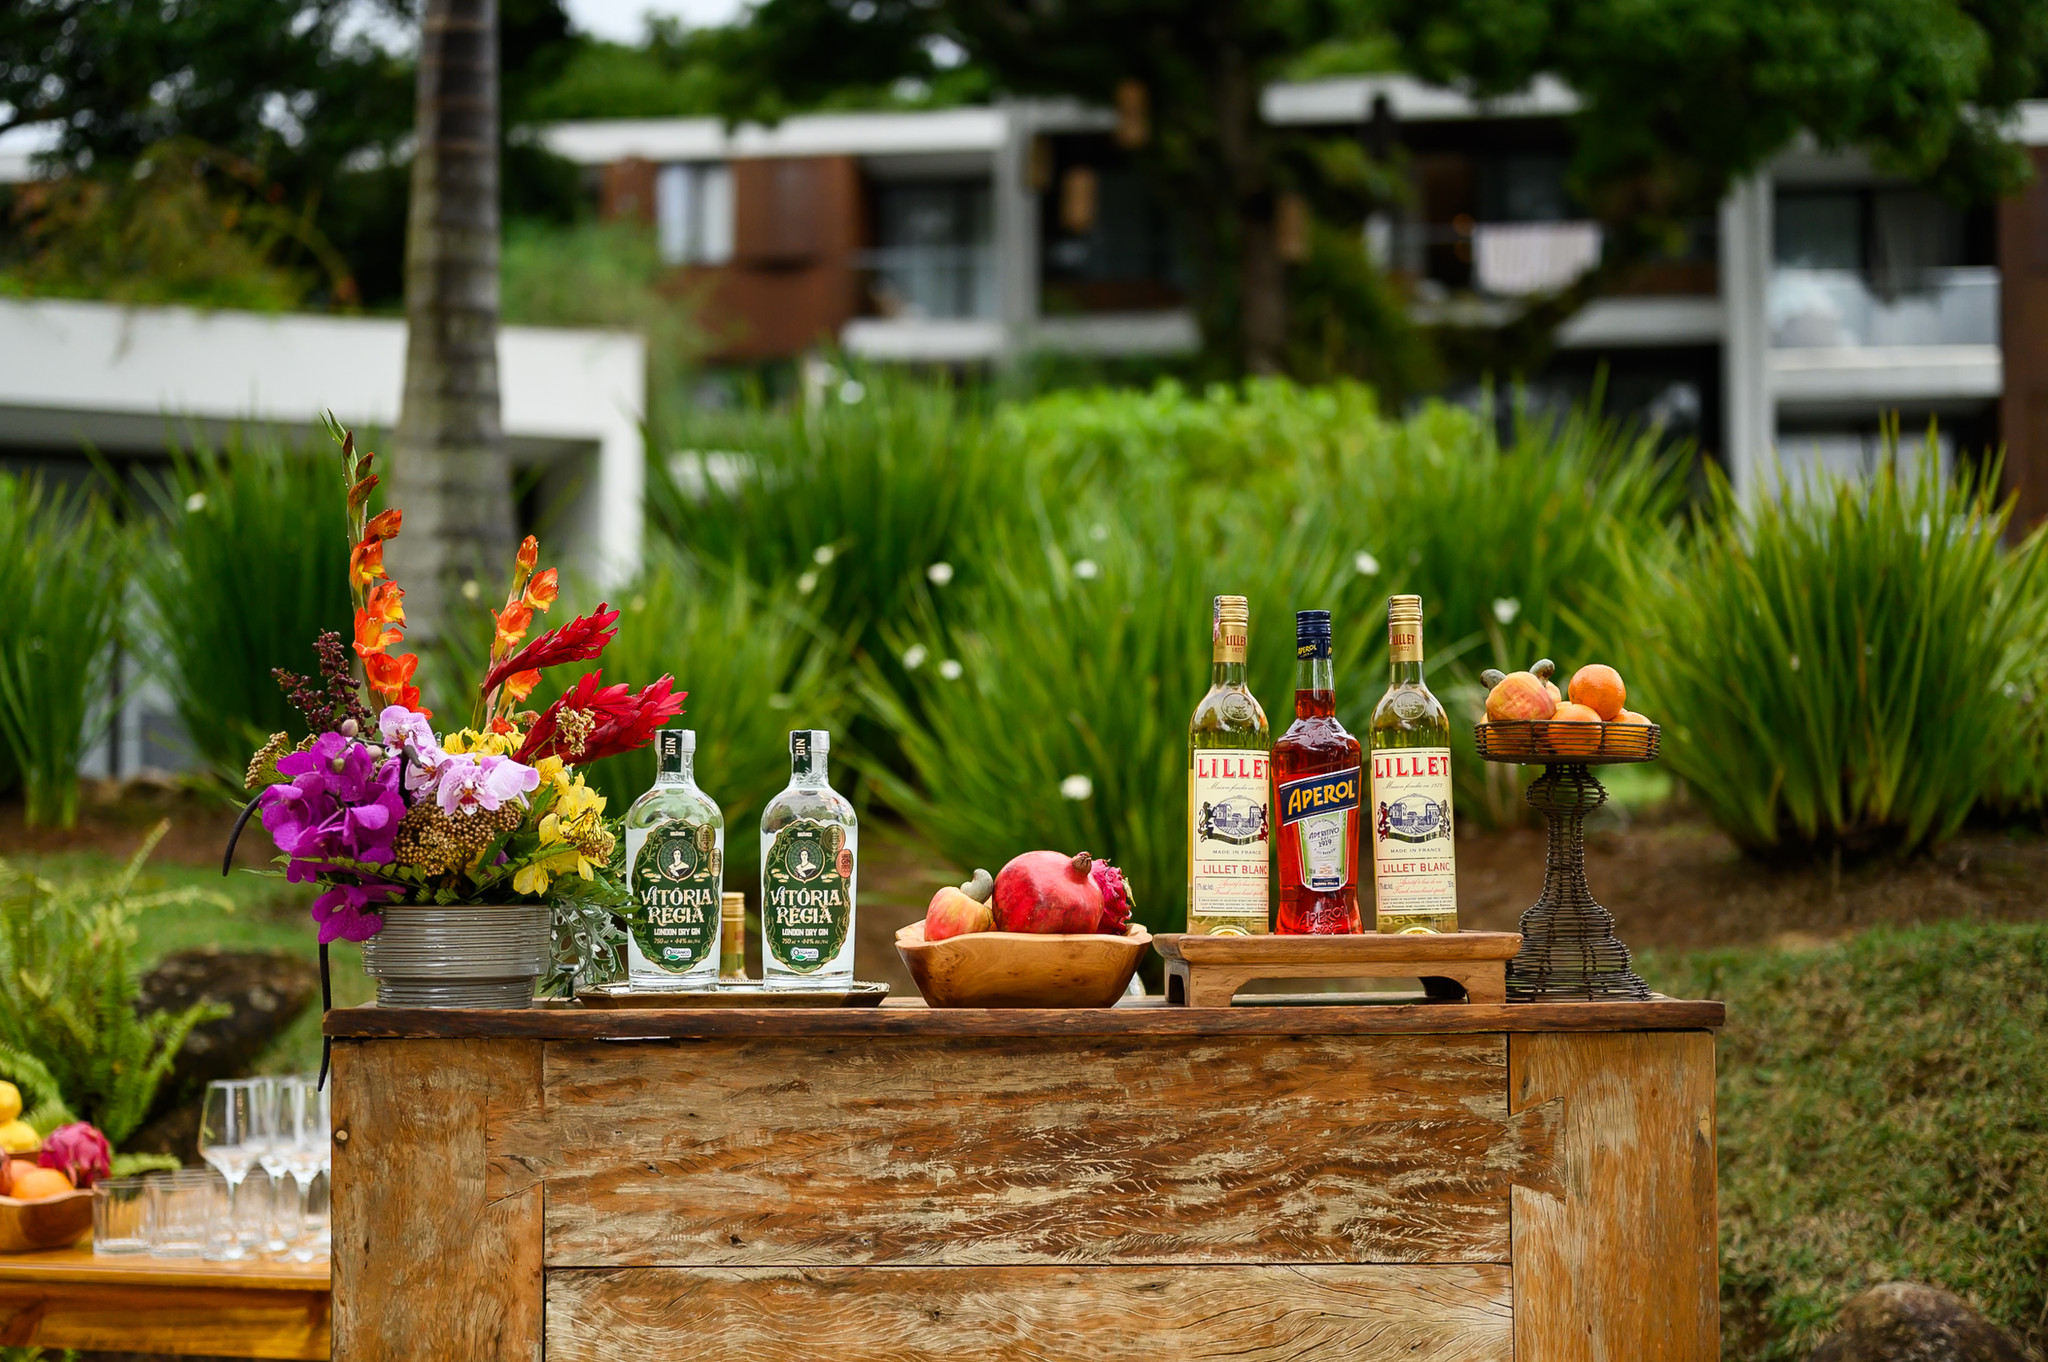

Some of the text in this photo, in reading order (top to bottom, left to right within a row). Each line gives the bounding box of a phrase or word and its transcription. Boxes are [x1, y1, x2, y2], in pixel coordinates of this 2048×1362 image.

[665, 737, 677, 755] GIN
[795, 738, 806, 756] GIN
[1374, 756, 1449, 778] LILLET
[1288, 779, 1356, 816] APEROL
[1309, 827, 1340, 840] APERITIVO
[1318, 839, 1332, 848] 1919
[1203, 864, 1238, 874] LILLET
[1383, 862, 1451, 874] LILLET BLANC
[640, 886, 714, 908] VITÓRIA
[770, 886, 843, 908] VITÓRIA
[647, 904, 705, 927] RÉGIA
[776, 904, 834, 927] RÉGIA
[653, 927, 701, 936] LONDON DRY GIN
[782, 928, 829, 936] LONDON DRY GIN
